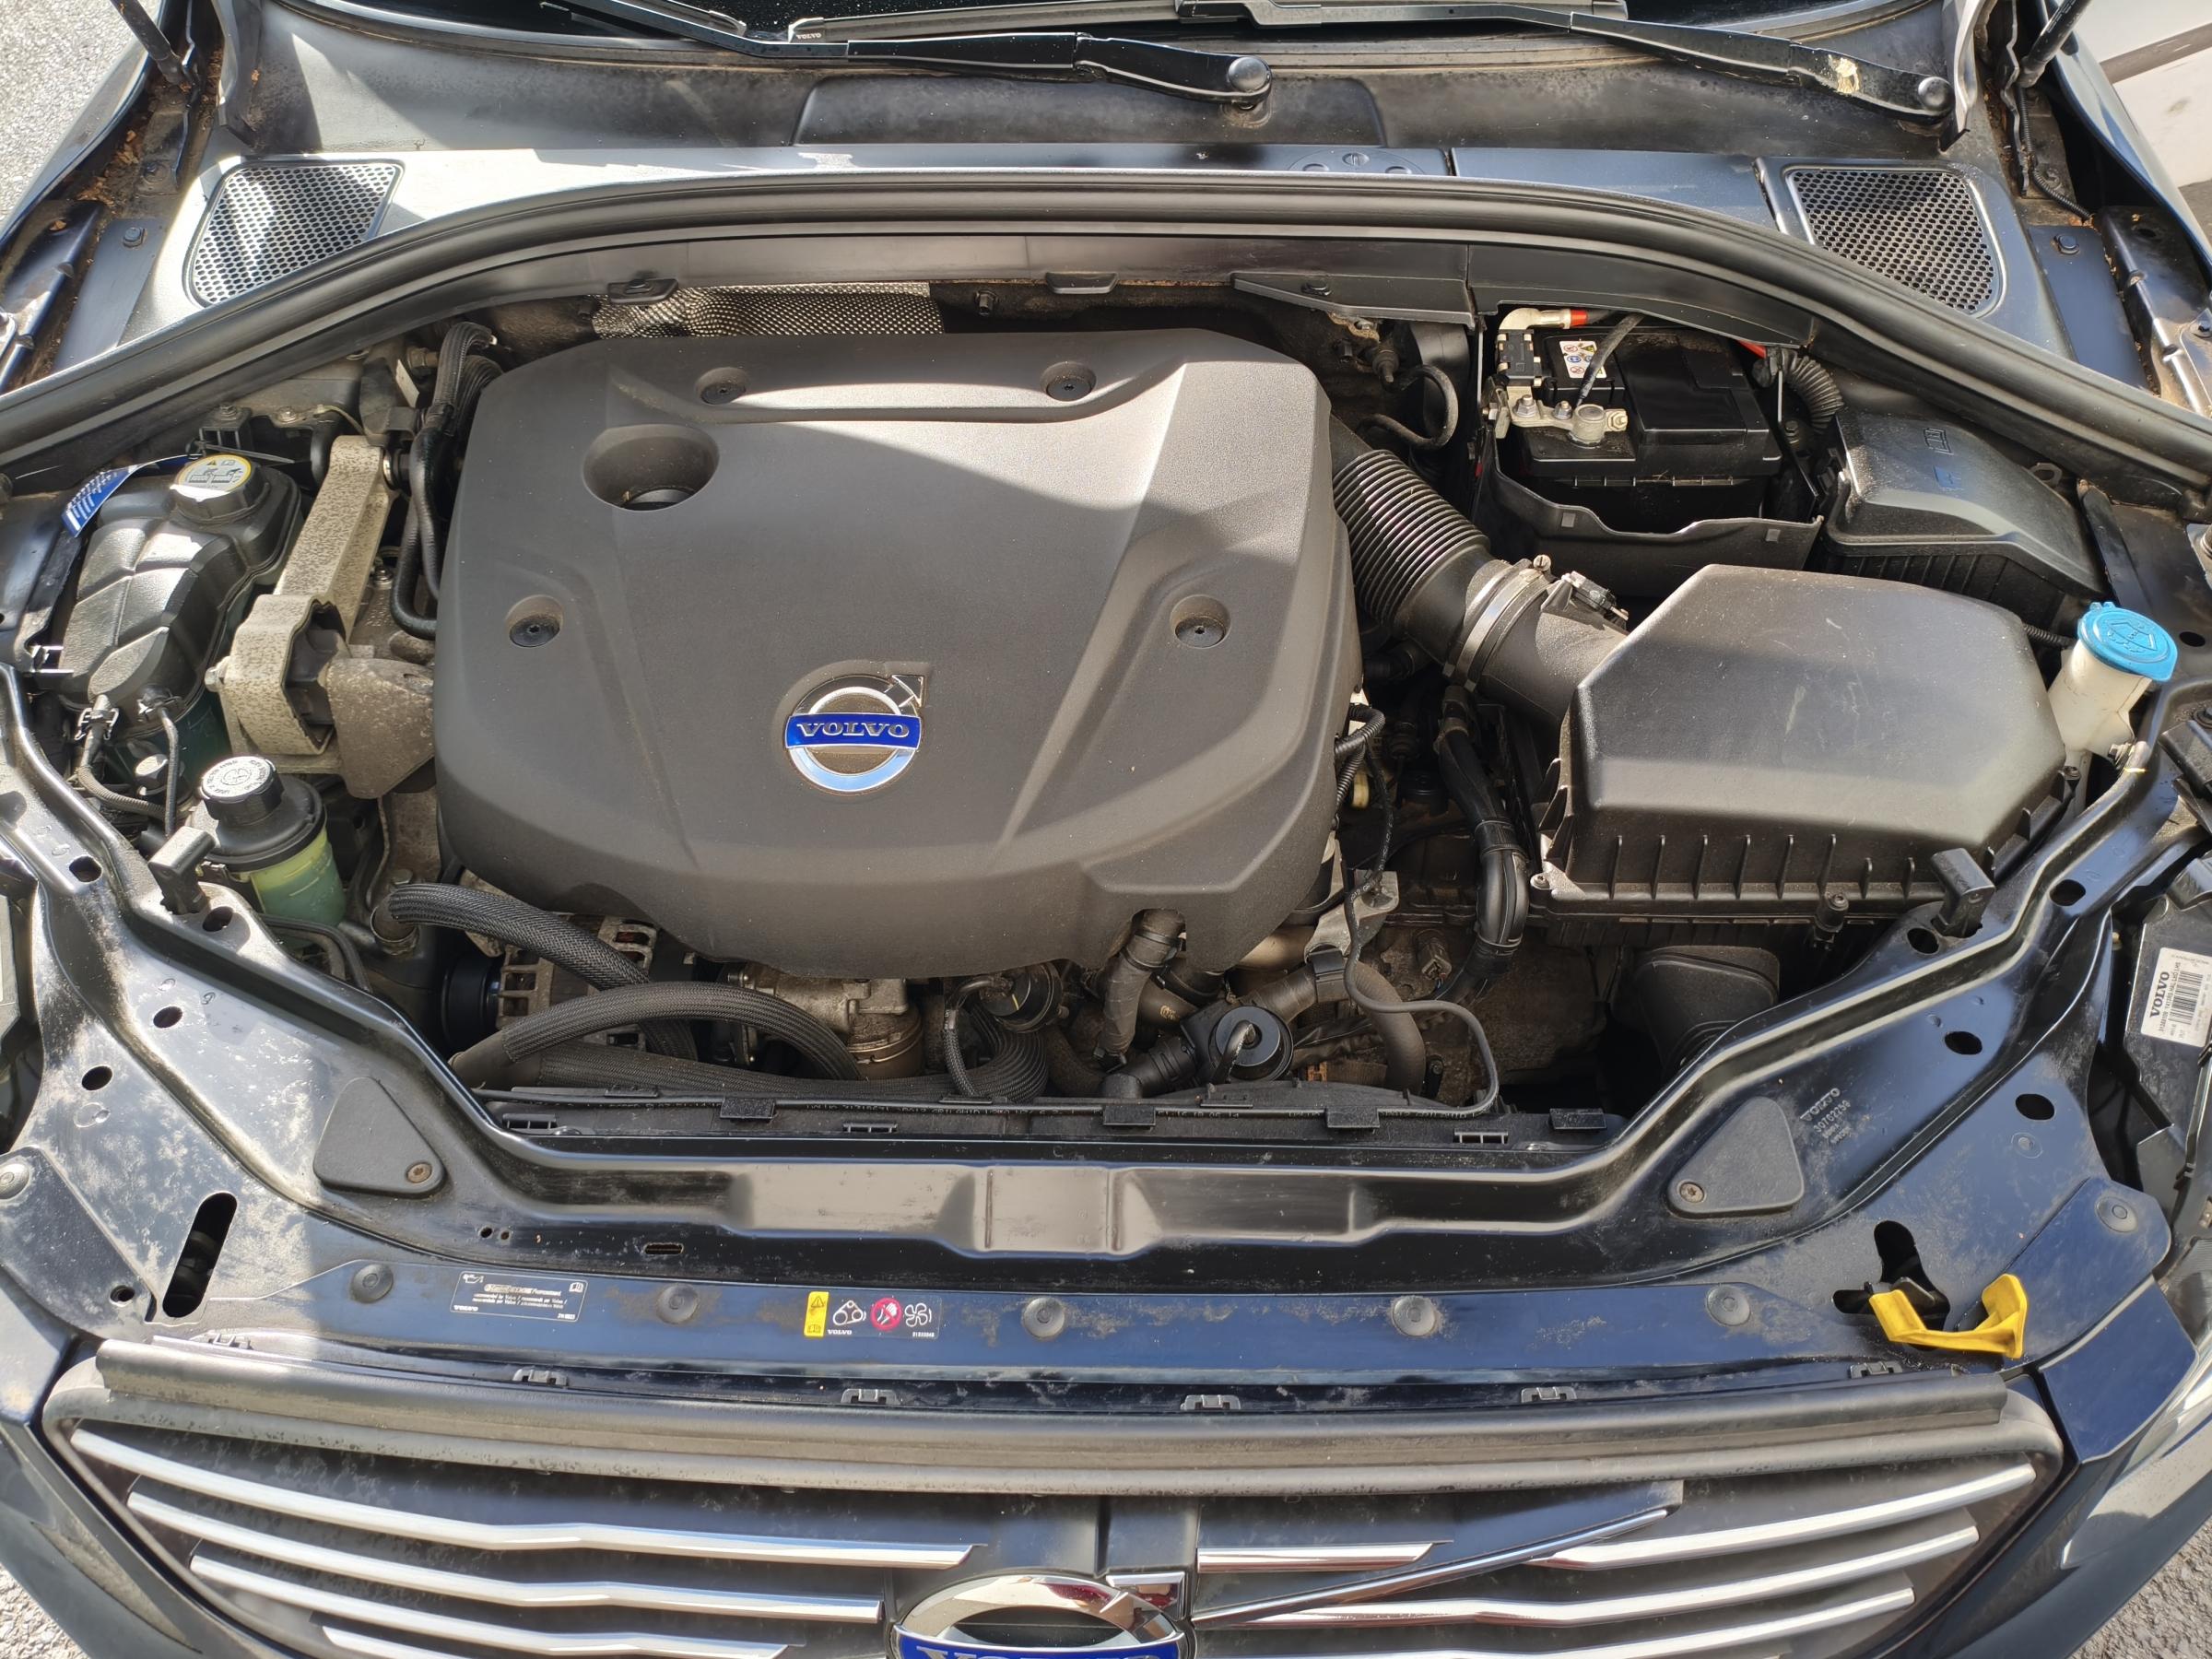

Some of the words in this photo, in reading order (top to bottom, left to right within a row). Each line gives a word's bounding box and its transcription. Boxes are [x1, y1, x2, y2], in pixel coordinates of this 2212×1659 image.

[796, 722, 910, 738] VOLVO
[2150, 971, 2170, 1018] VOLVO
[1800, 1088, 1841, 1122] VOLVO
